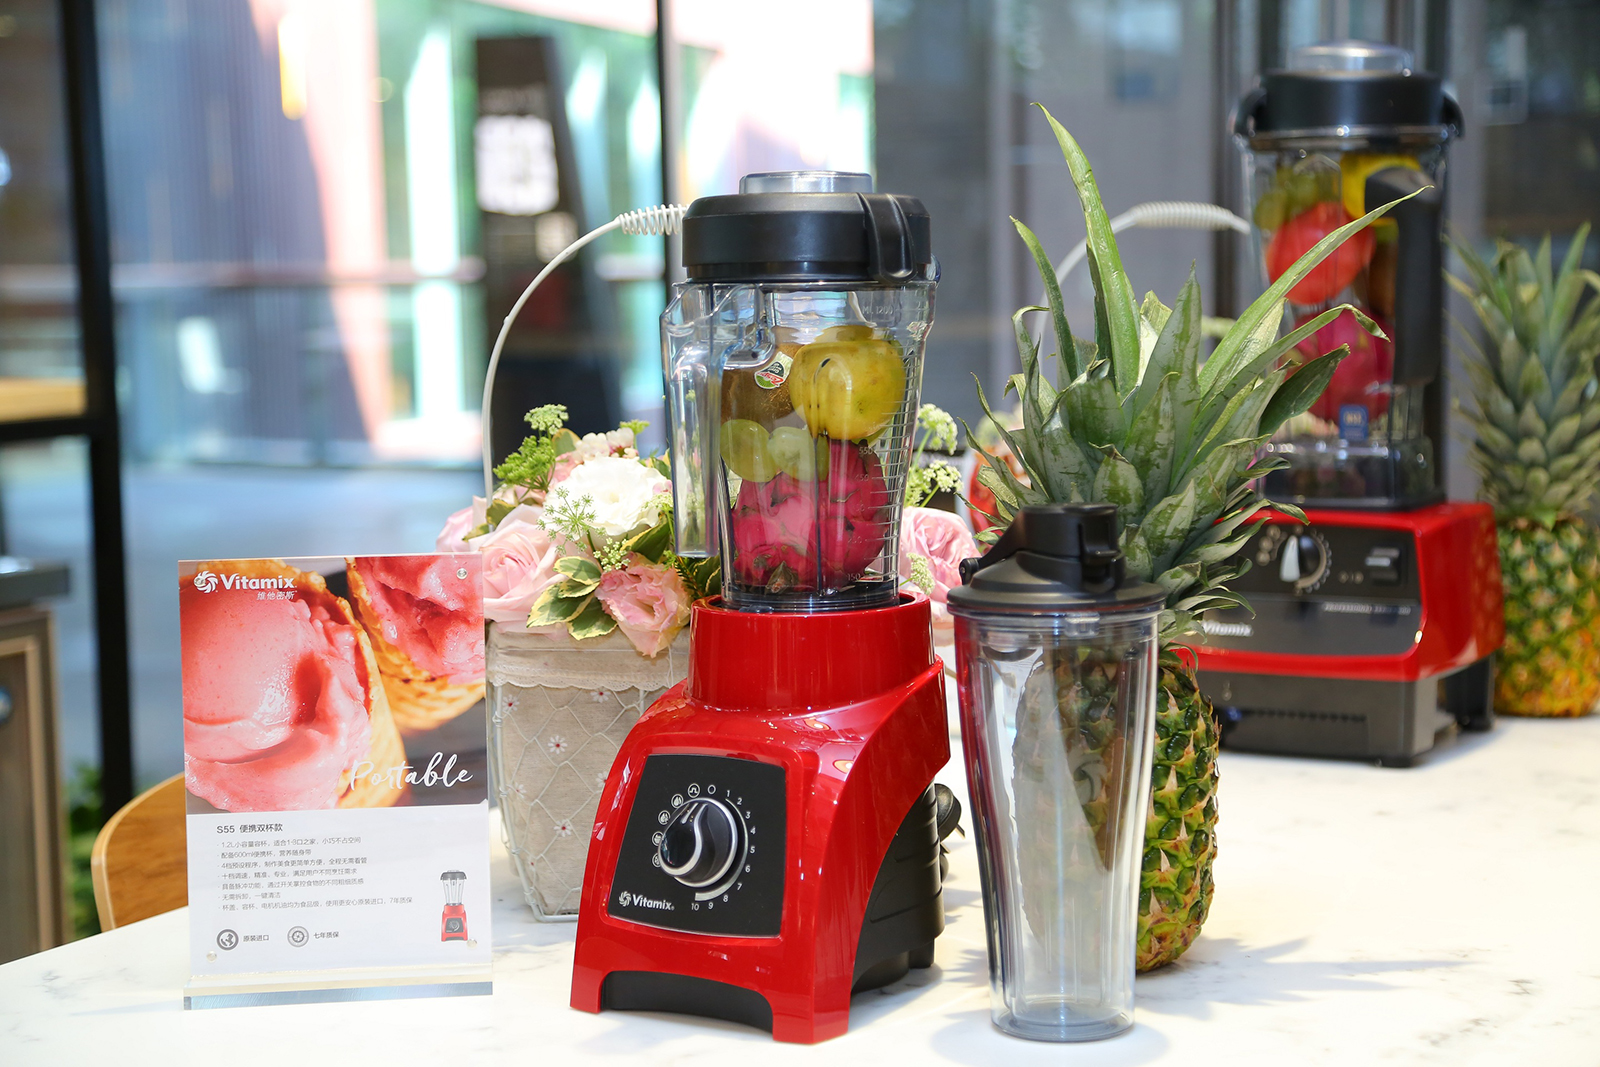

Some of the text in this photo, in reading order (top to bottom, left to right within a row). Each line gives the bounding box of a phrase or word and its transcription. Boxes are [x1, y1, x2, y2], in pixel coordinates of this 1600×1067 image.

[859, 446, 874, 455] 550
[220, 573, 295, 590] Vitamix
[350, 751, 474, 791] Portable
[745, 811, 751, 819] 3
[216, 823, 283, 834] S55 便携双杯款
[750, 826, 756, 835] 4
[750, 846, 756, 854] 5
[745, 865, 751, 873] 6
[737, 883, 743, 891] 7
[632, 893, 671, 911] Vitamix
[723, 894, 729, 902] 8
[691, 902, 700, 911] 10
[708, 902, 714, 910] 9
[313, 931, 339, 940] 七年质保
